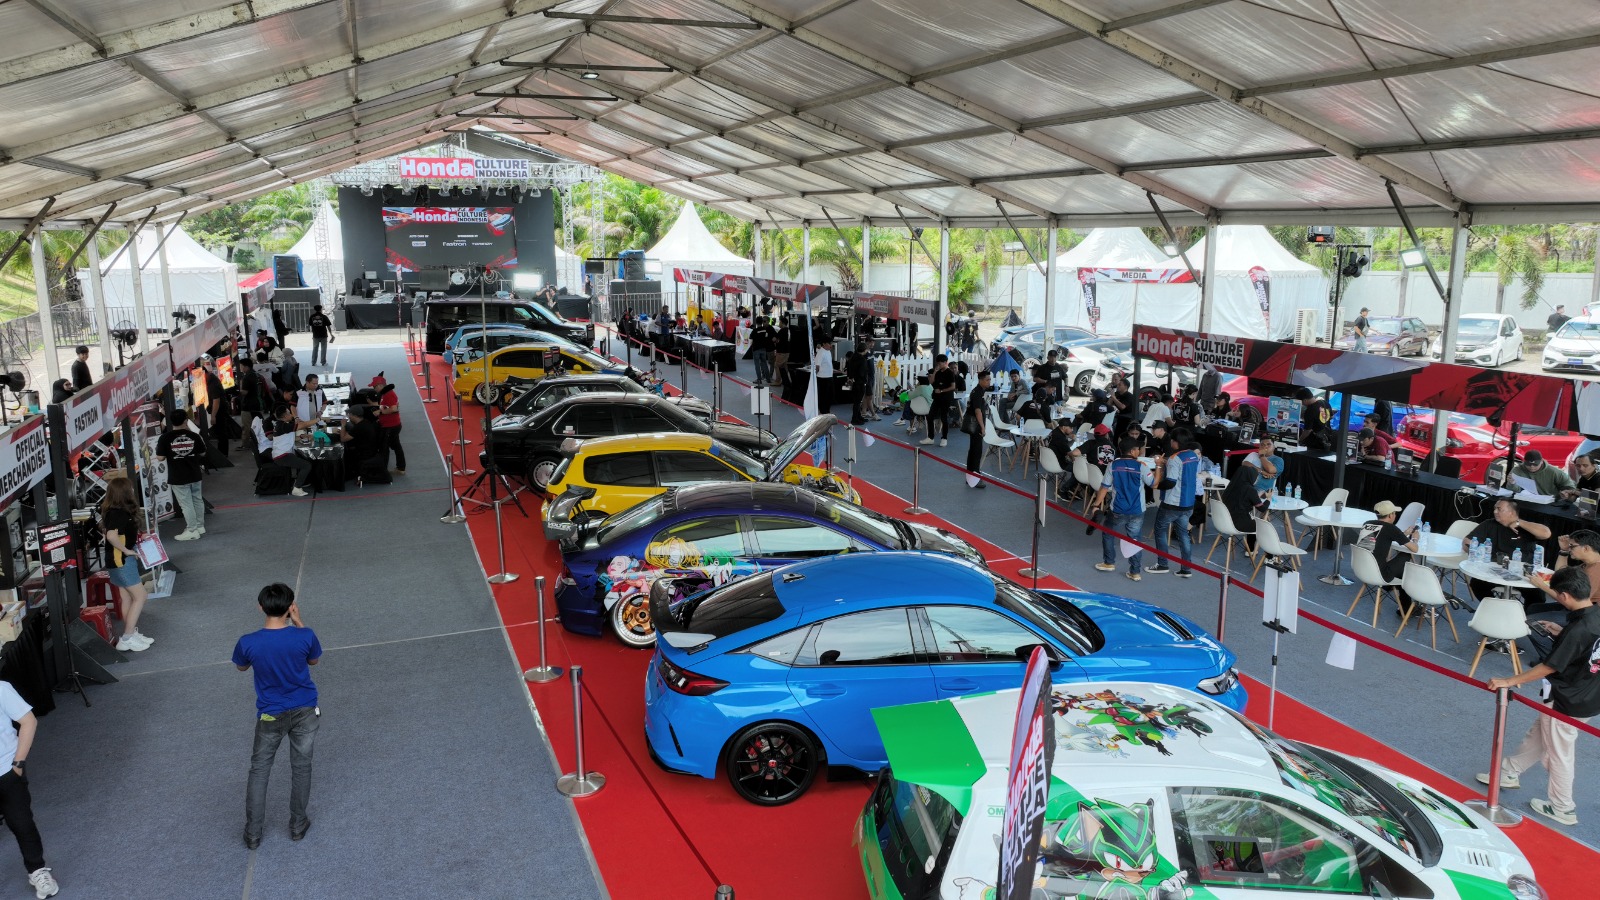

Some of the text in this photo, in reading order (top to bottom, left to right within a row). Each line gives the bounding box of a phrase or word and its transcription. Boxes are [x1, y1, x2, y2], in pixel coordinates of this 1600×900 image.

[402, 159, 473, 176] Honda
[475, 160, 527, 169] CULTURE
[416, 212, 457, 222] Honda
[1121, 271, 1147, 279] MEDIA
[782, 286, 793, 296] AREA
[903, 305, 928, 316] KIDS AREA
[1136, 332, 1193, 359] Honda
[1194, 339, 1243, 357] CULTURE
[1193, 352, 1242, 368] INDONESIA
[111, 378, 135, 415] Honda
[74, 405, 99, 435] FASTRON
[16, 430, 44, 462] OFFICIAL
[987, 807, 1004, 815] OM
